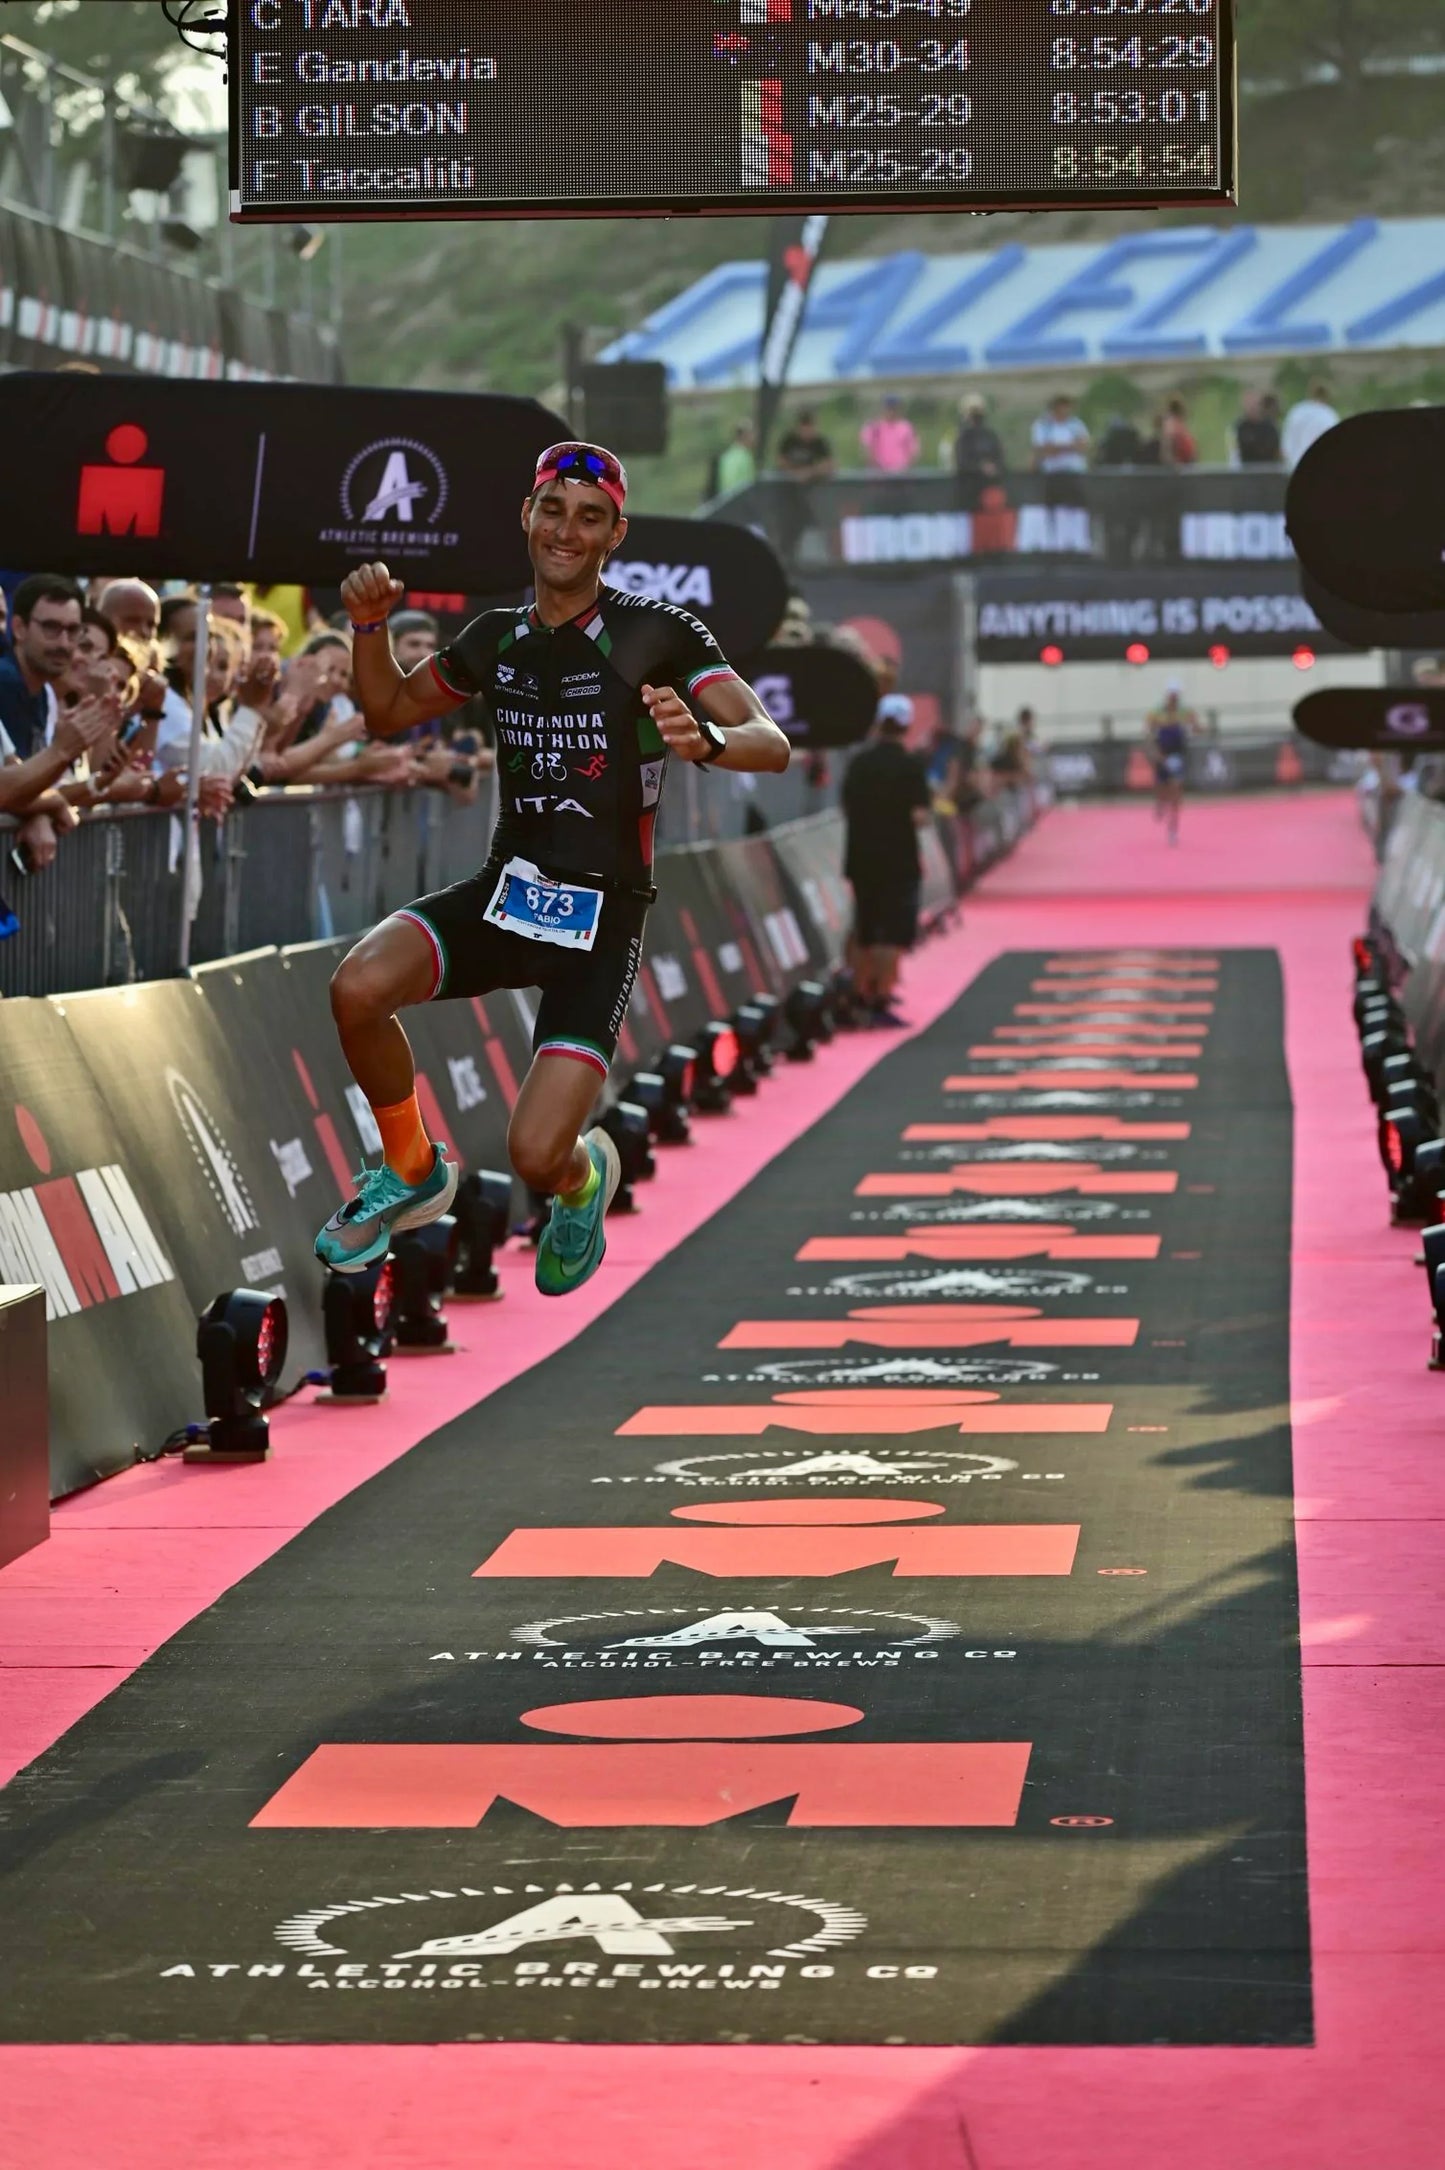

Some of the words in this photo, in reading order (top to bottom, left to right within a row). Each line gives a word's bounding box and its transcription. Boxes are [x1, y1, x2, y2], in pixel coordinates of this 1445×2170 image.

[253, 52, 281, 83] E
[295, 48, 497, 83] Gandevia
[807, 39, 971, 73] M30-34
[1050, 36, 1213, 69] 8:54:29
[252, 105, 282, 138] B
[295, 101, 467, 137] GILSON
[807, 94, 972, 128] M25-29
[1050, 90, 1210, 124] 8:53:01
[252, 160, 279, 191] F
[295, 156, 475, 191] Taccaliti
[807, 147, 972, 181] M25-29
[1052, 144, 1213, 178] 8:54:54
[979, 602, 1157, 637] ANYTHING
[1164, 599, 1199, 634] IS
[561, 671, 600, 684] ACADEMY
[496, 708, 604, 728] CIVITANOVA
[501, 728, 608, 750] TRIATHLON
[526, 886, 574, 917] 873
[608, 937, 640, 1033] CIVITANOVA
[428, 1651, 672, 1661] ATHLETIC
[698, 1650, 940, 1660] BREWING
[542, 1660, 776, 1669] ALCOHOL-FREE
[793, 1659, 900, 1668] BREWS
[159, 1963, 483, 1977] ATHLETIC
[514, 1961, 836, 1979] BREWING
[307, 1977, 618, 1990] ALCOHOL-FREE
[638, 1978, 782, 1990] BREWS
